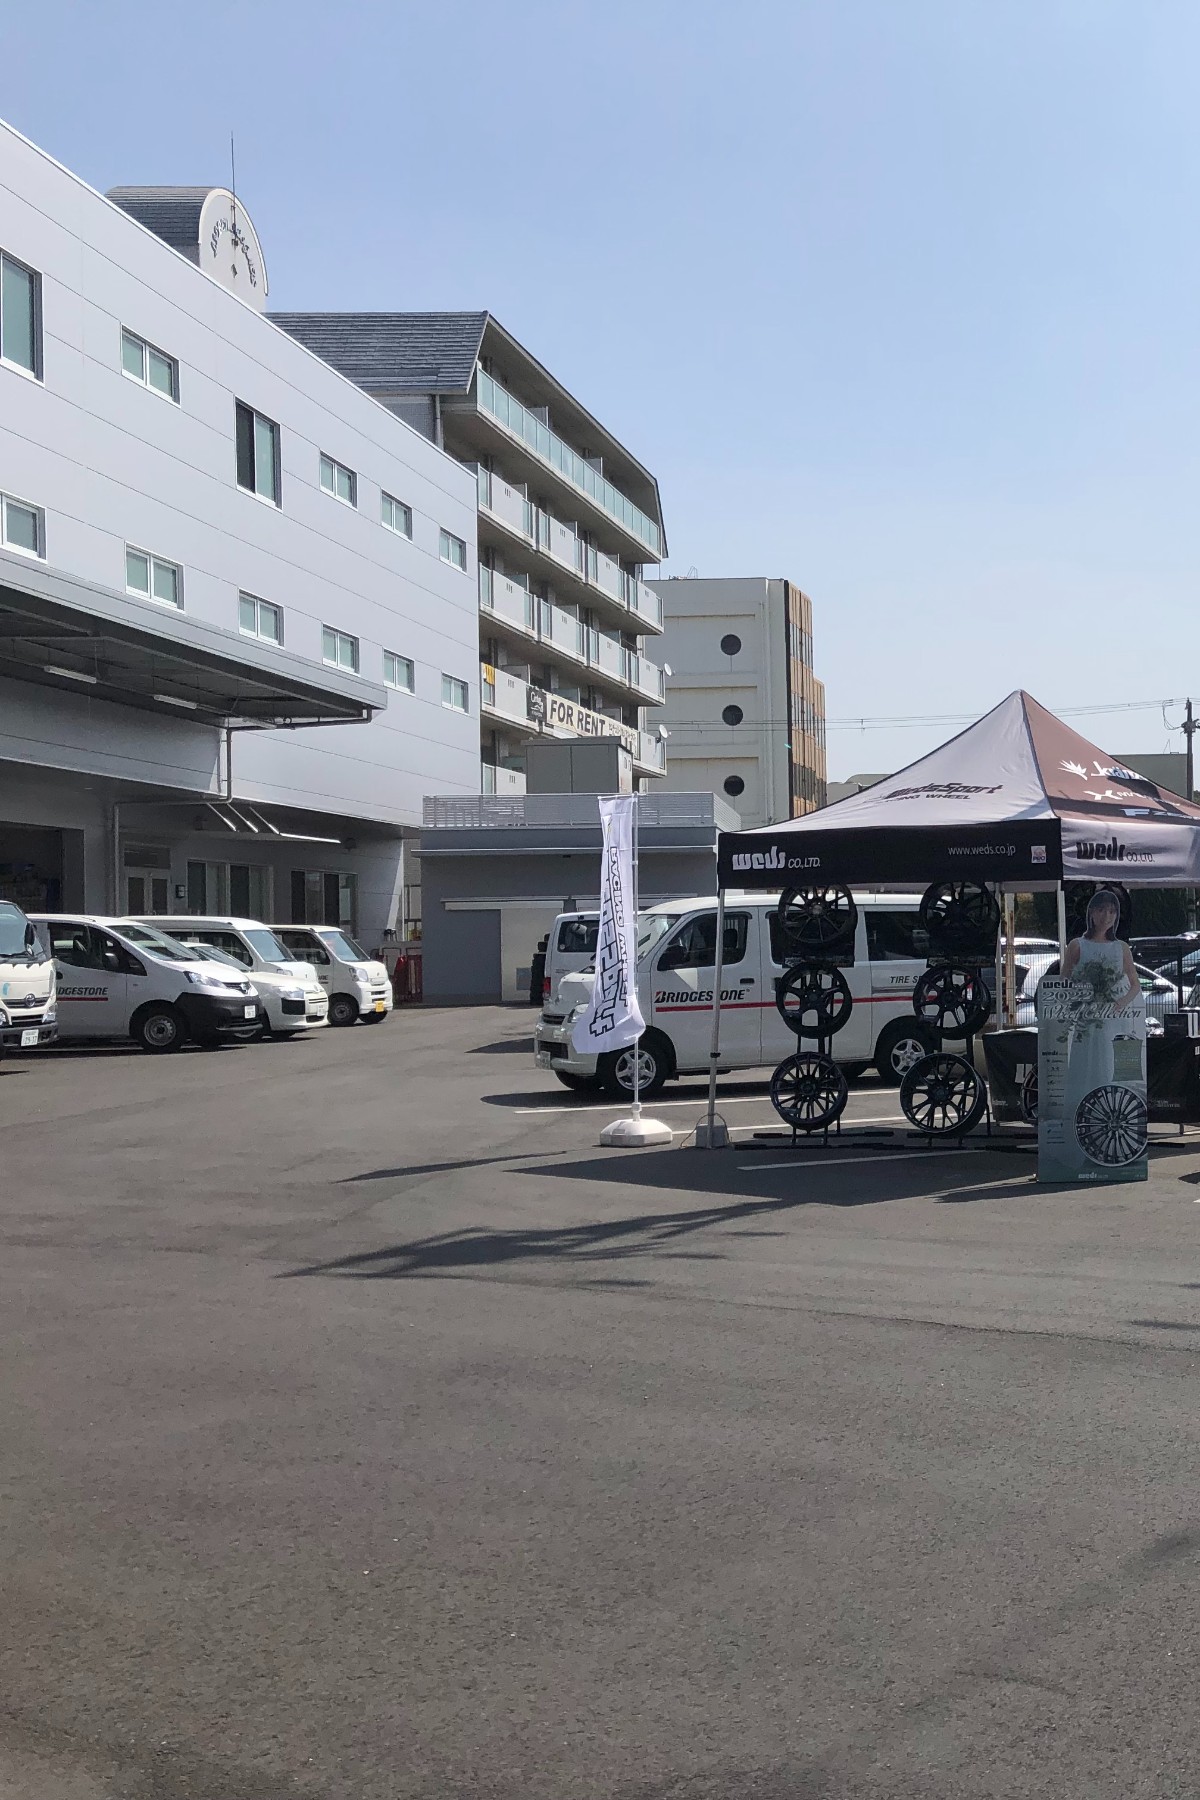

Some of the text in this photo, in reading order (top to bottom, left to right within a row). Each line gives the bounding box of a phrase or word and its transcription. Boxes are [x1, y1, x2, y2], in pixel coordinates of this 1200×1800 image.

[550, 700, 574, 726] FOR
[577, 709, 605, 737] RENT
[948, 844, 1016, 856] www.weds.co.jp
[1076, 837, 1126, 861] weds
[732, 846, 786, 870] weds
[1042, 979, 1073, 989] weds
[654, 989, 746, 1003] BRIDGESONE
[1042, 991, 1092, 1002] 2022
[1042, 1001, 1141, 1019] Wheel Collection
